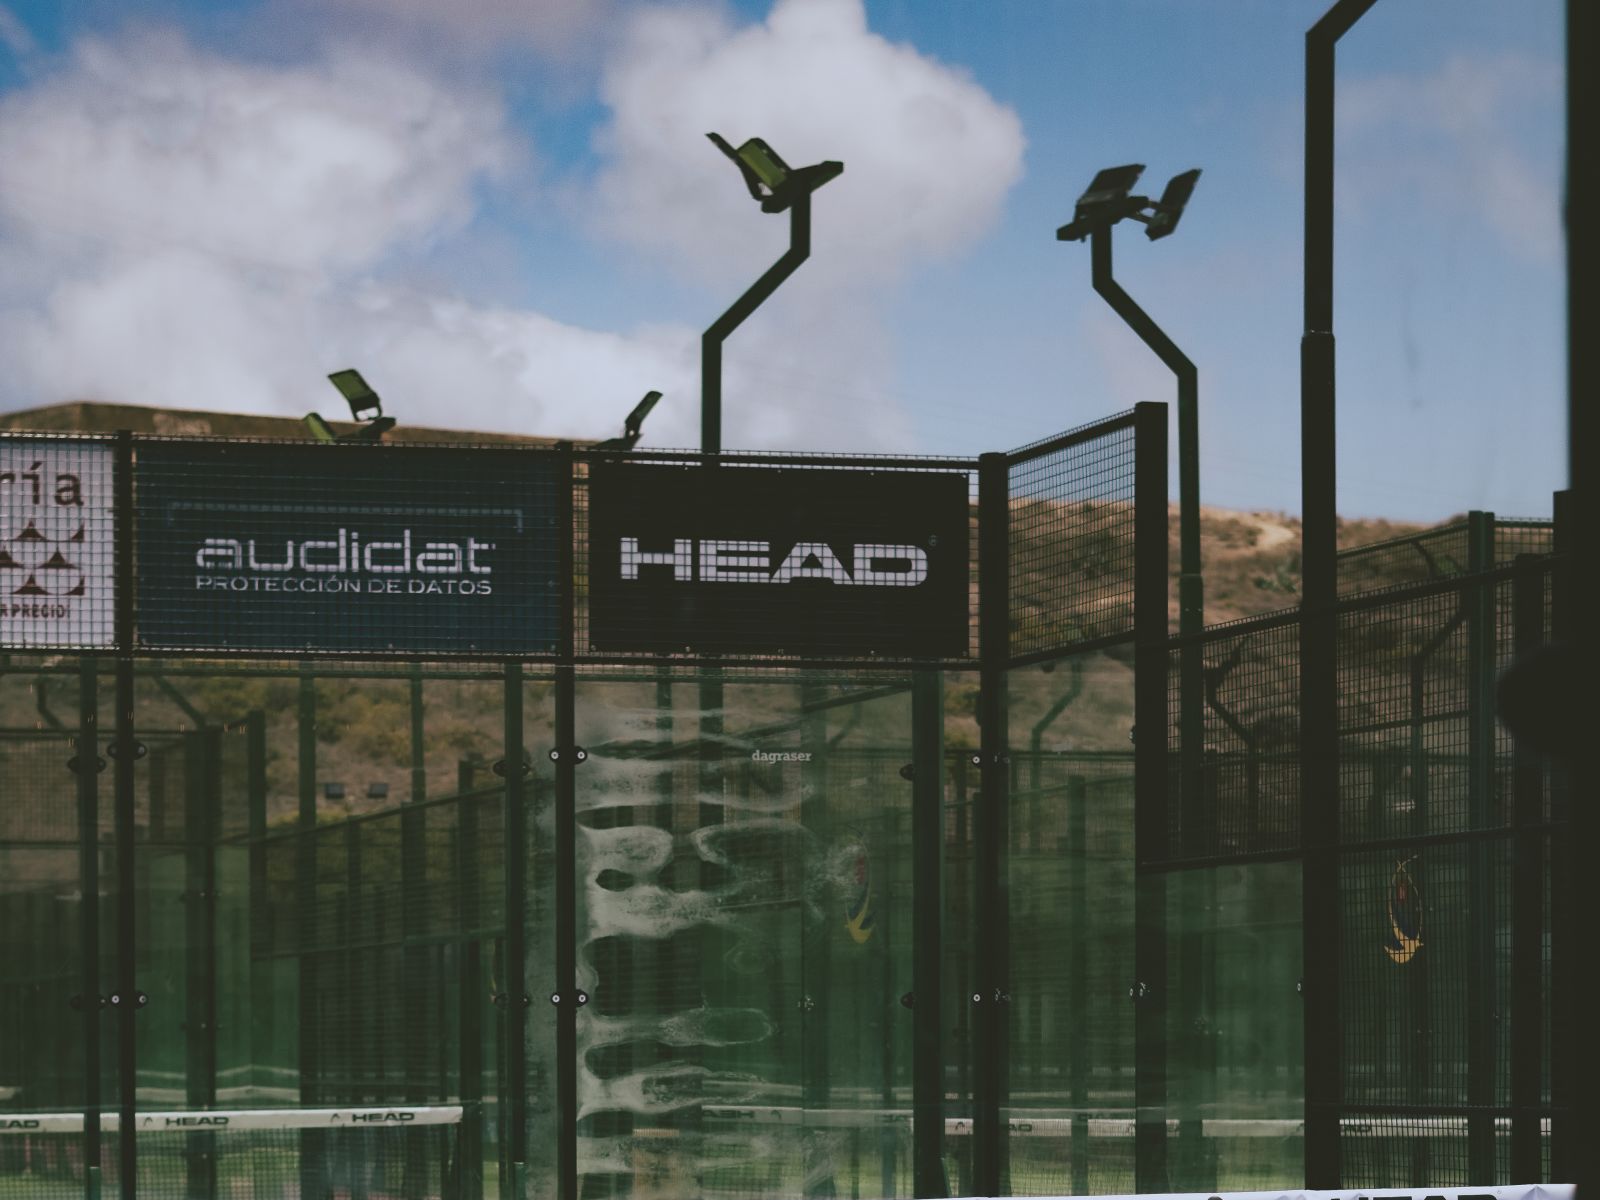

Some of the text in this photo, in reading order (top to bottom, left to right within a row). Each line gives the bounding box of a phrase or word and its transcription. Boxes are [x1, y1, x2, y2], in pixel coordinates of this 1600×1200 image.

[196, 528, 492, 573] audidat
[620, 538, 928, 586] HEAD
[196, 575, 492, 594] PROTECCIÓN DE DATOS
[751, 749, 812, 764] dagraser
[166, 1116, 229, 1126] HEAD
[352, 1112, 415, 1123] HEAD
